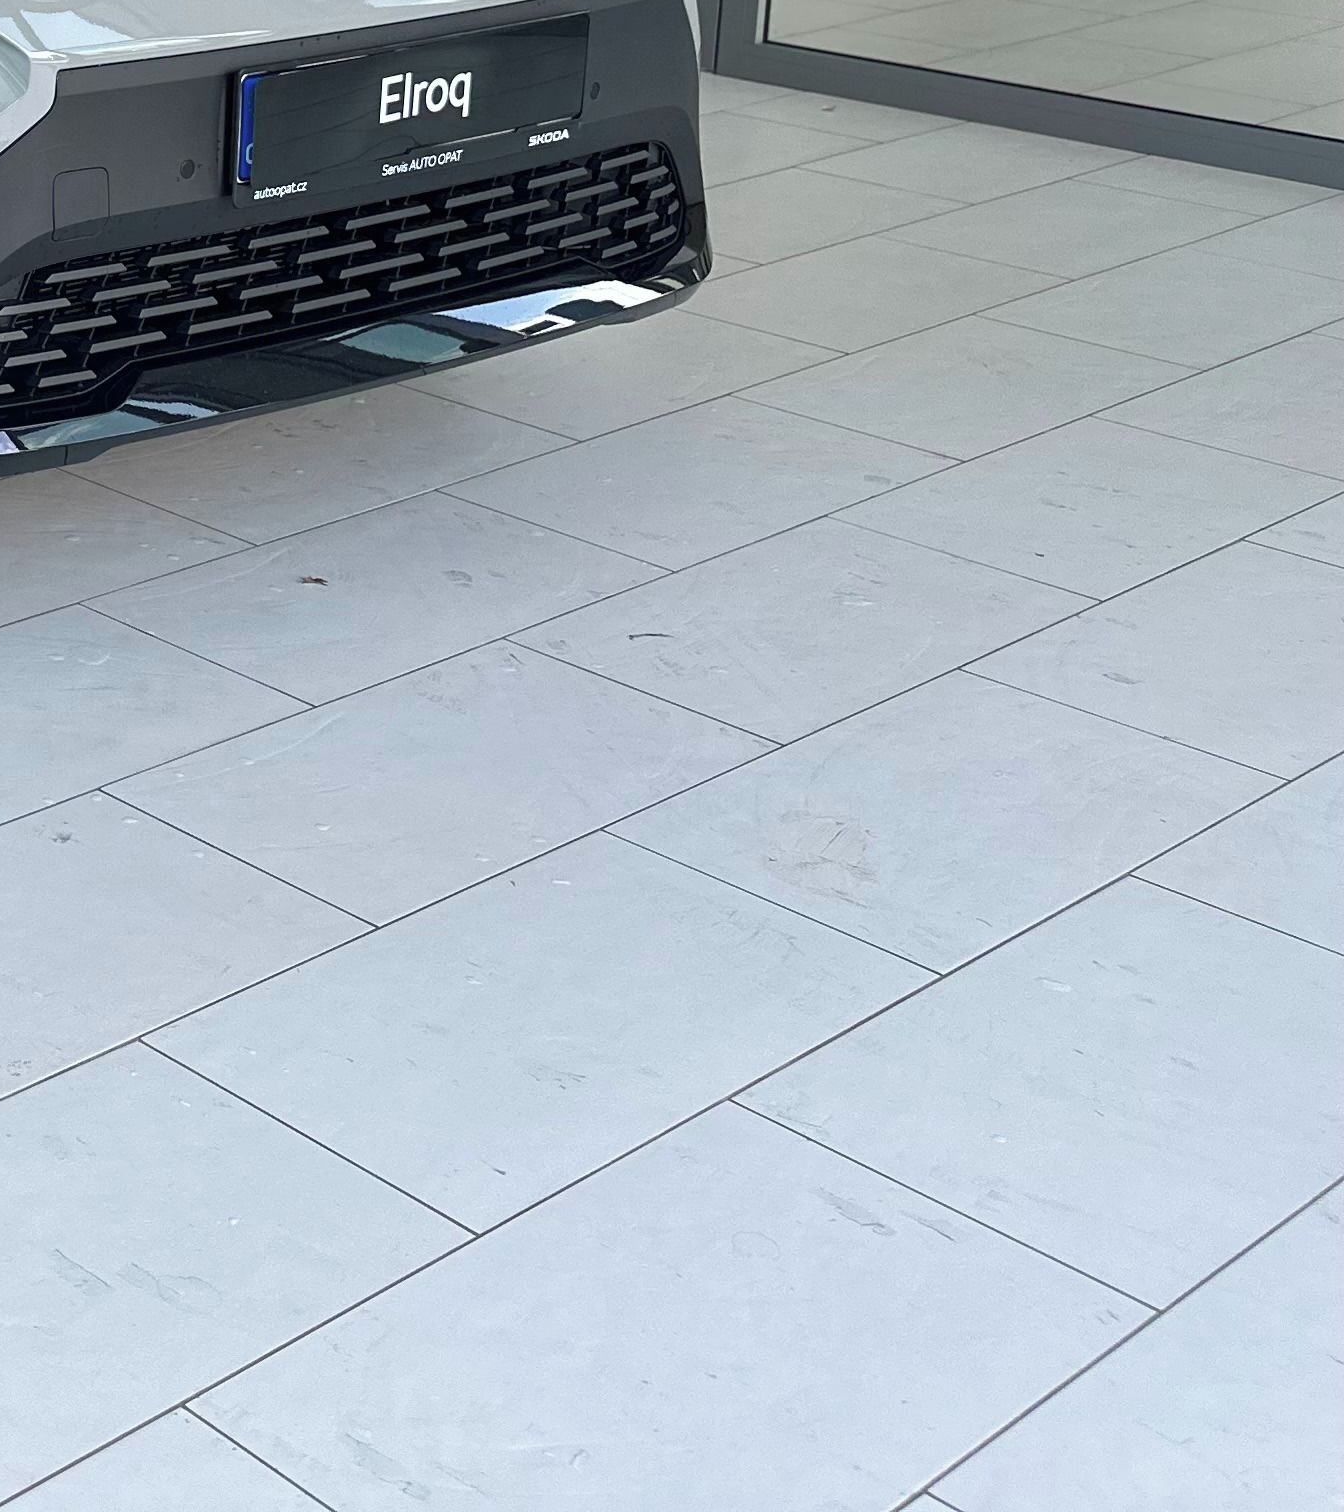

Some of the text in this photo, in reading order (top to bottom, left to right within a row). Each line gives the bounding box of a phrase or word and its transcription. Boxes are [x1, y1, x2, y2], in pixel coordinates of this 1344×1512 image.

[379, 71, 472, 124] Elroq
[381, 149, 464, 177] Servis AUTO OPAT
[253, 181, 308, 201] autoopat.cz
